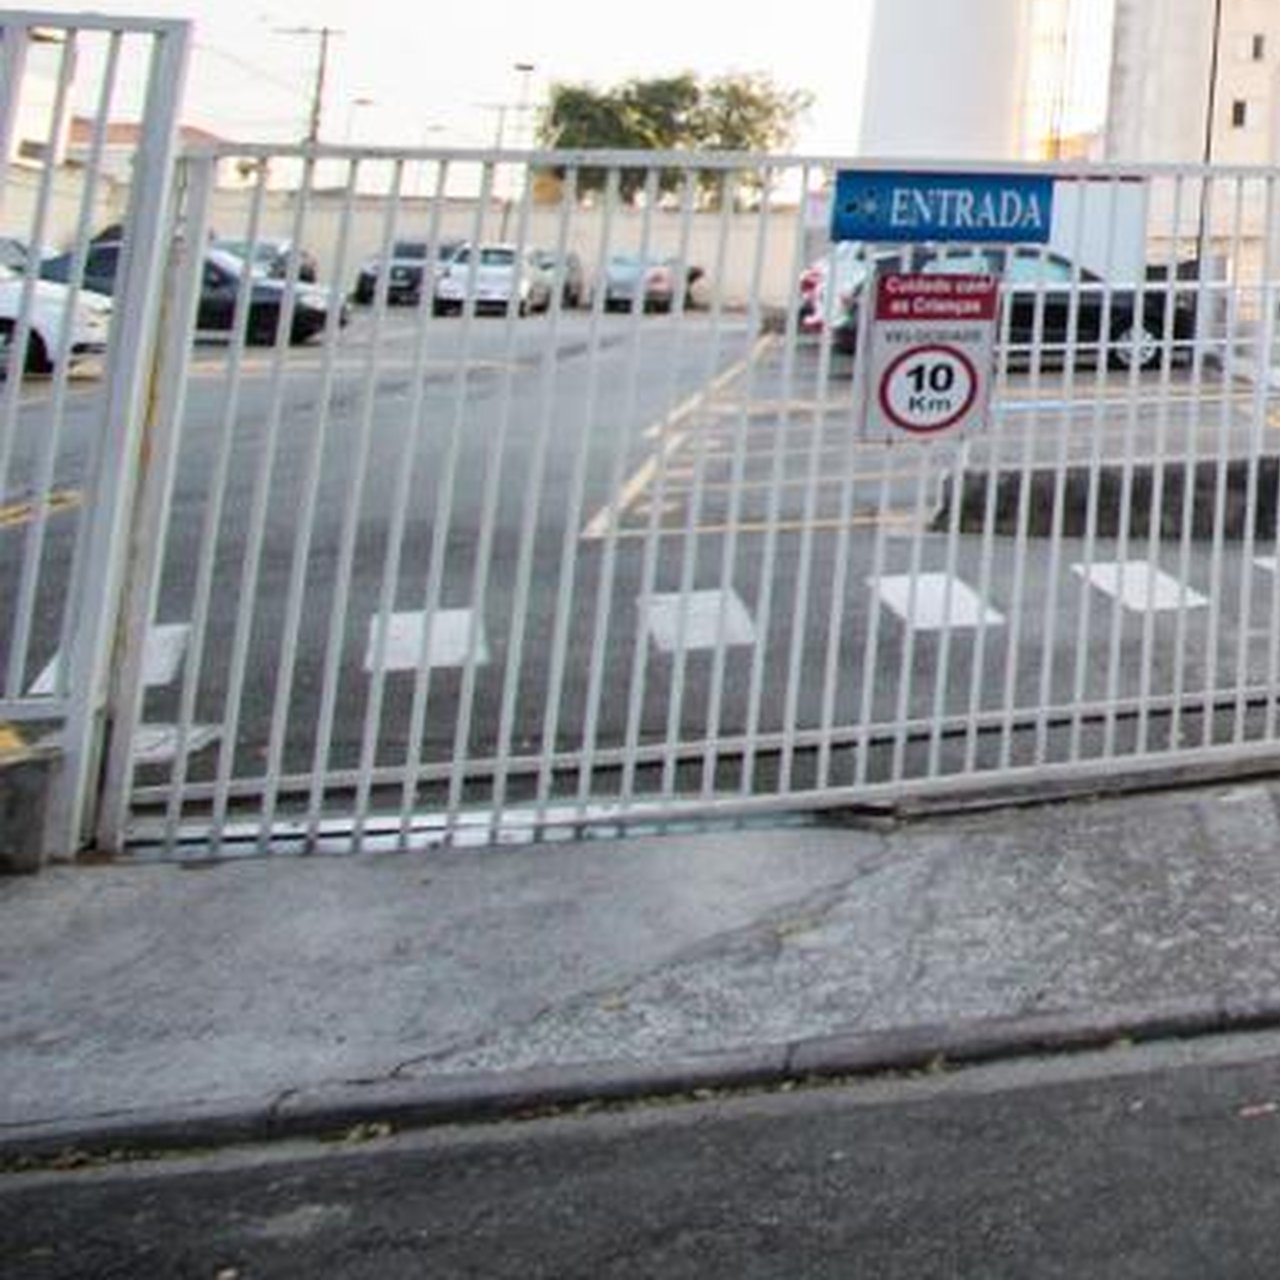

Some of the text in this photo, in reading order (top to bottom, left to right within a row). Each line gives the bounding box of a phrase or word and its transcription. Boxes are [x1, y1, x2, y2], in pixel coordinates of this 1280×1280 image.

[890, 188, 1043, 227] ENTRADA
[885, 275, 951, 294] Cuidado
[913, 297, 981, 315] Crianças
[906, 363, 954, 393] 10
[908, 396, 951, 411] Km
